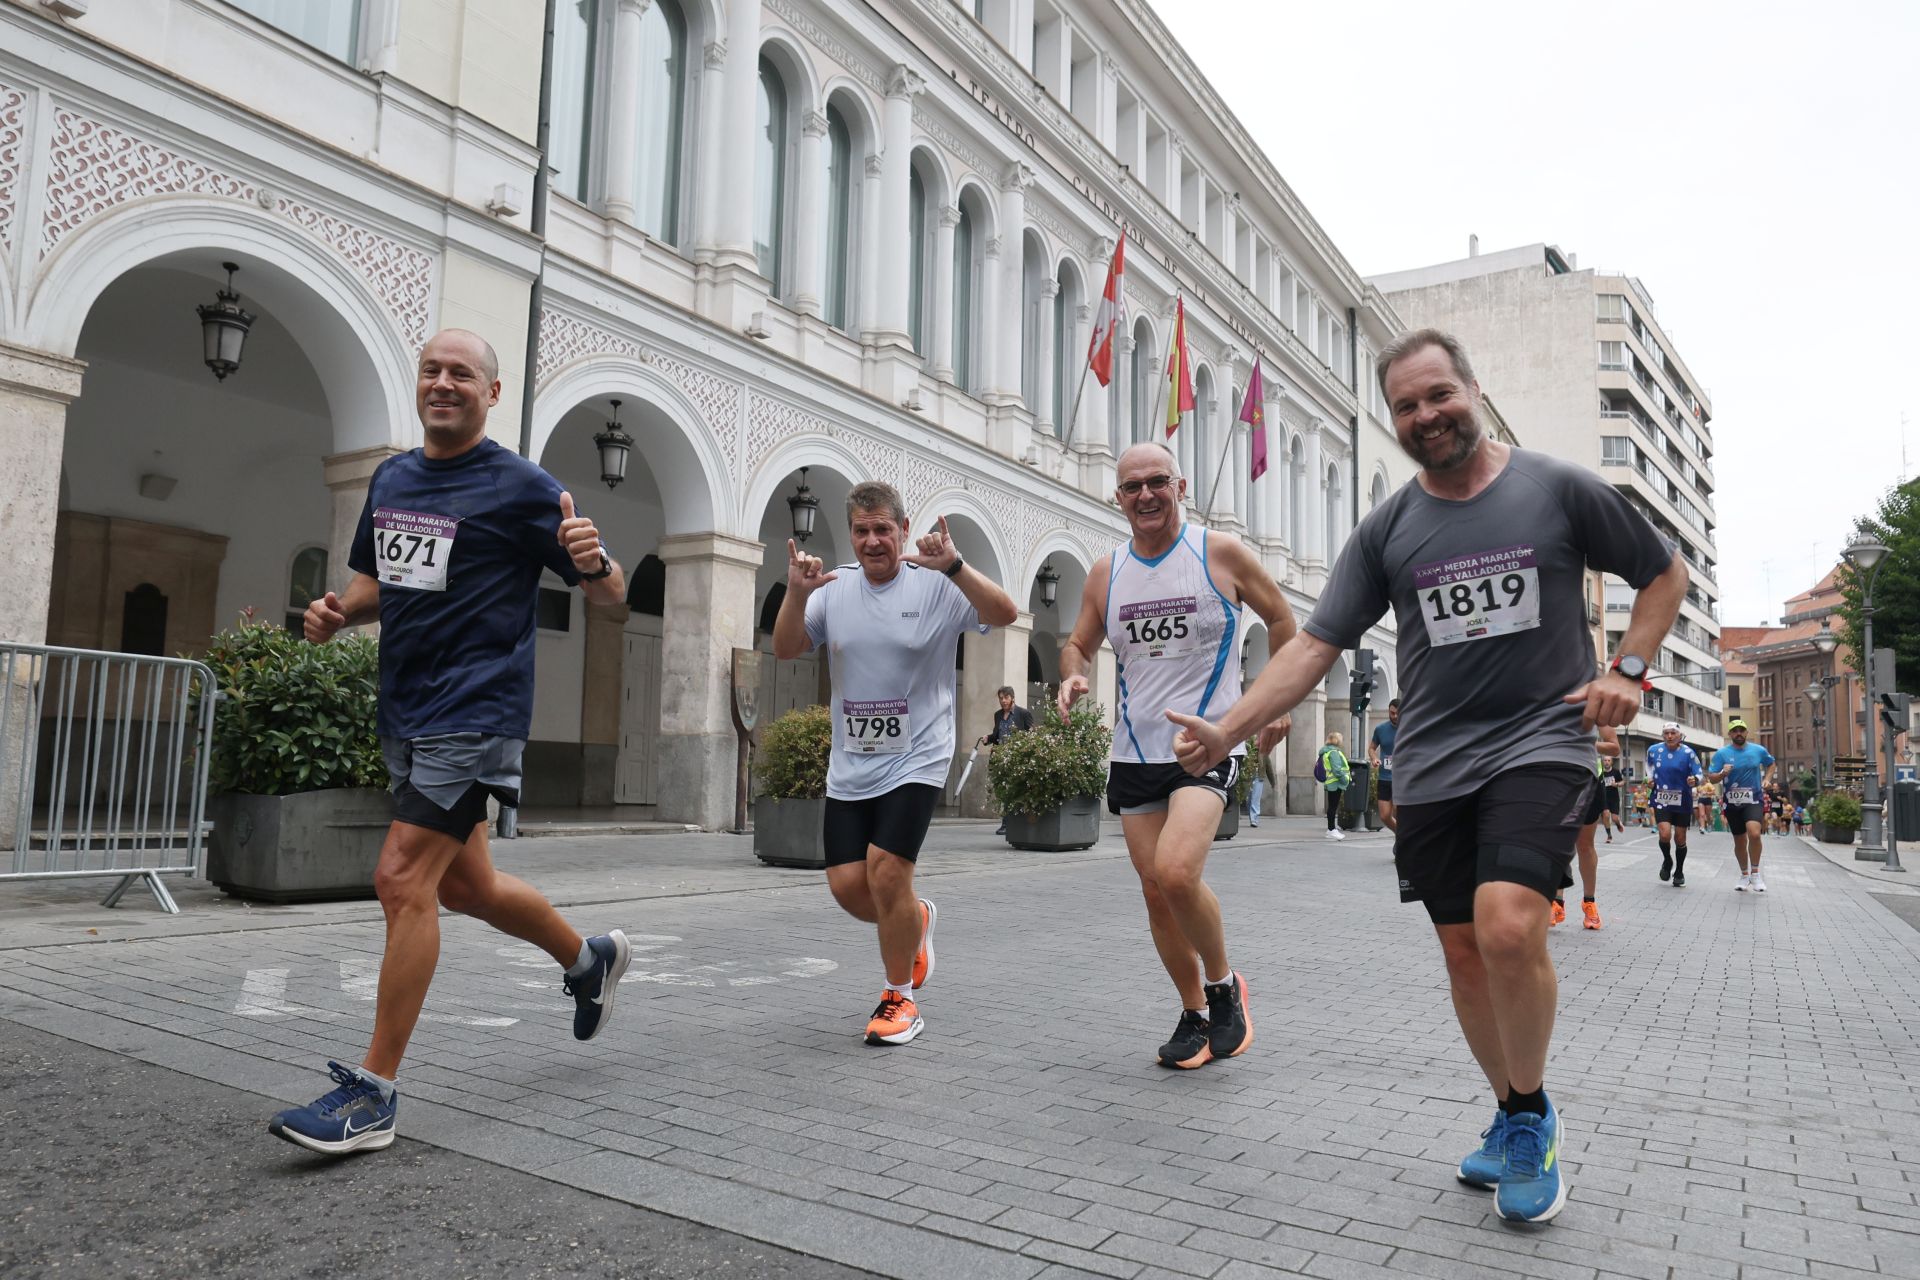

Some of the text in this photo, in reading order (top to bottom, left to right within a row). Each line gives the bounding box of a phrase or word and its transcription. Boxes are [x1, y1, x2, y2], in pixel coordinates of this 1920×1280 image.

[968, 79, 1035, 149] TEATRO
[392, 512, 416, 522] MEDIA
[417, 518, 456, 529] MARATÓN
[396, 522, 442, 535] VALLADOLID
[377, 531, 437, 567] 1671
[1444, 558, 1478, 572] MEDIA
[1480, 546, 1532, 565] MARATÓN
[1438, 561, 1520, 584] DE VALLADOLID
[1138, 603, 1160, 611] MEDIA
[1427, 574, 1525, 622] 1819
[1144, 607, 1186, 618] VALLADOLID
[1126, 616, 1188, 644] 1665
[846, 716, 901, 738] 1798
[1658, 792, 1679, 801] 1075
